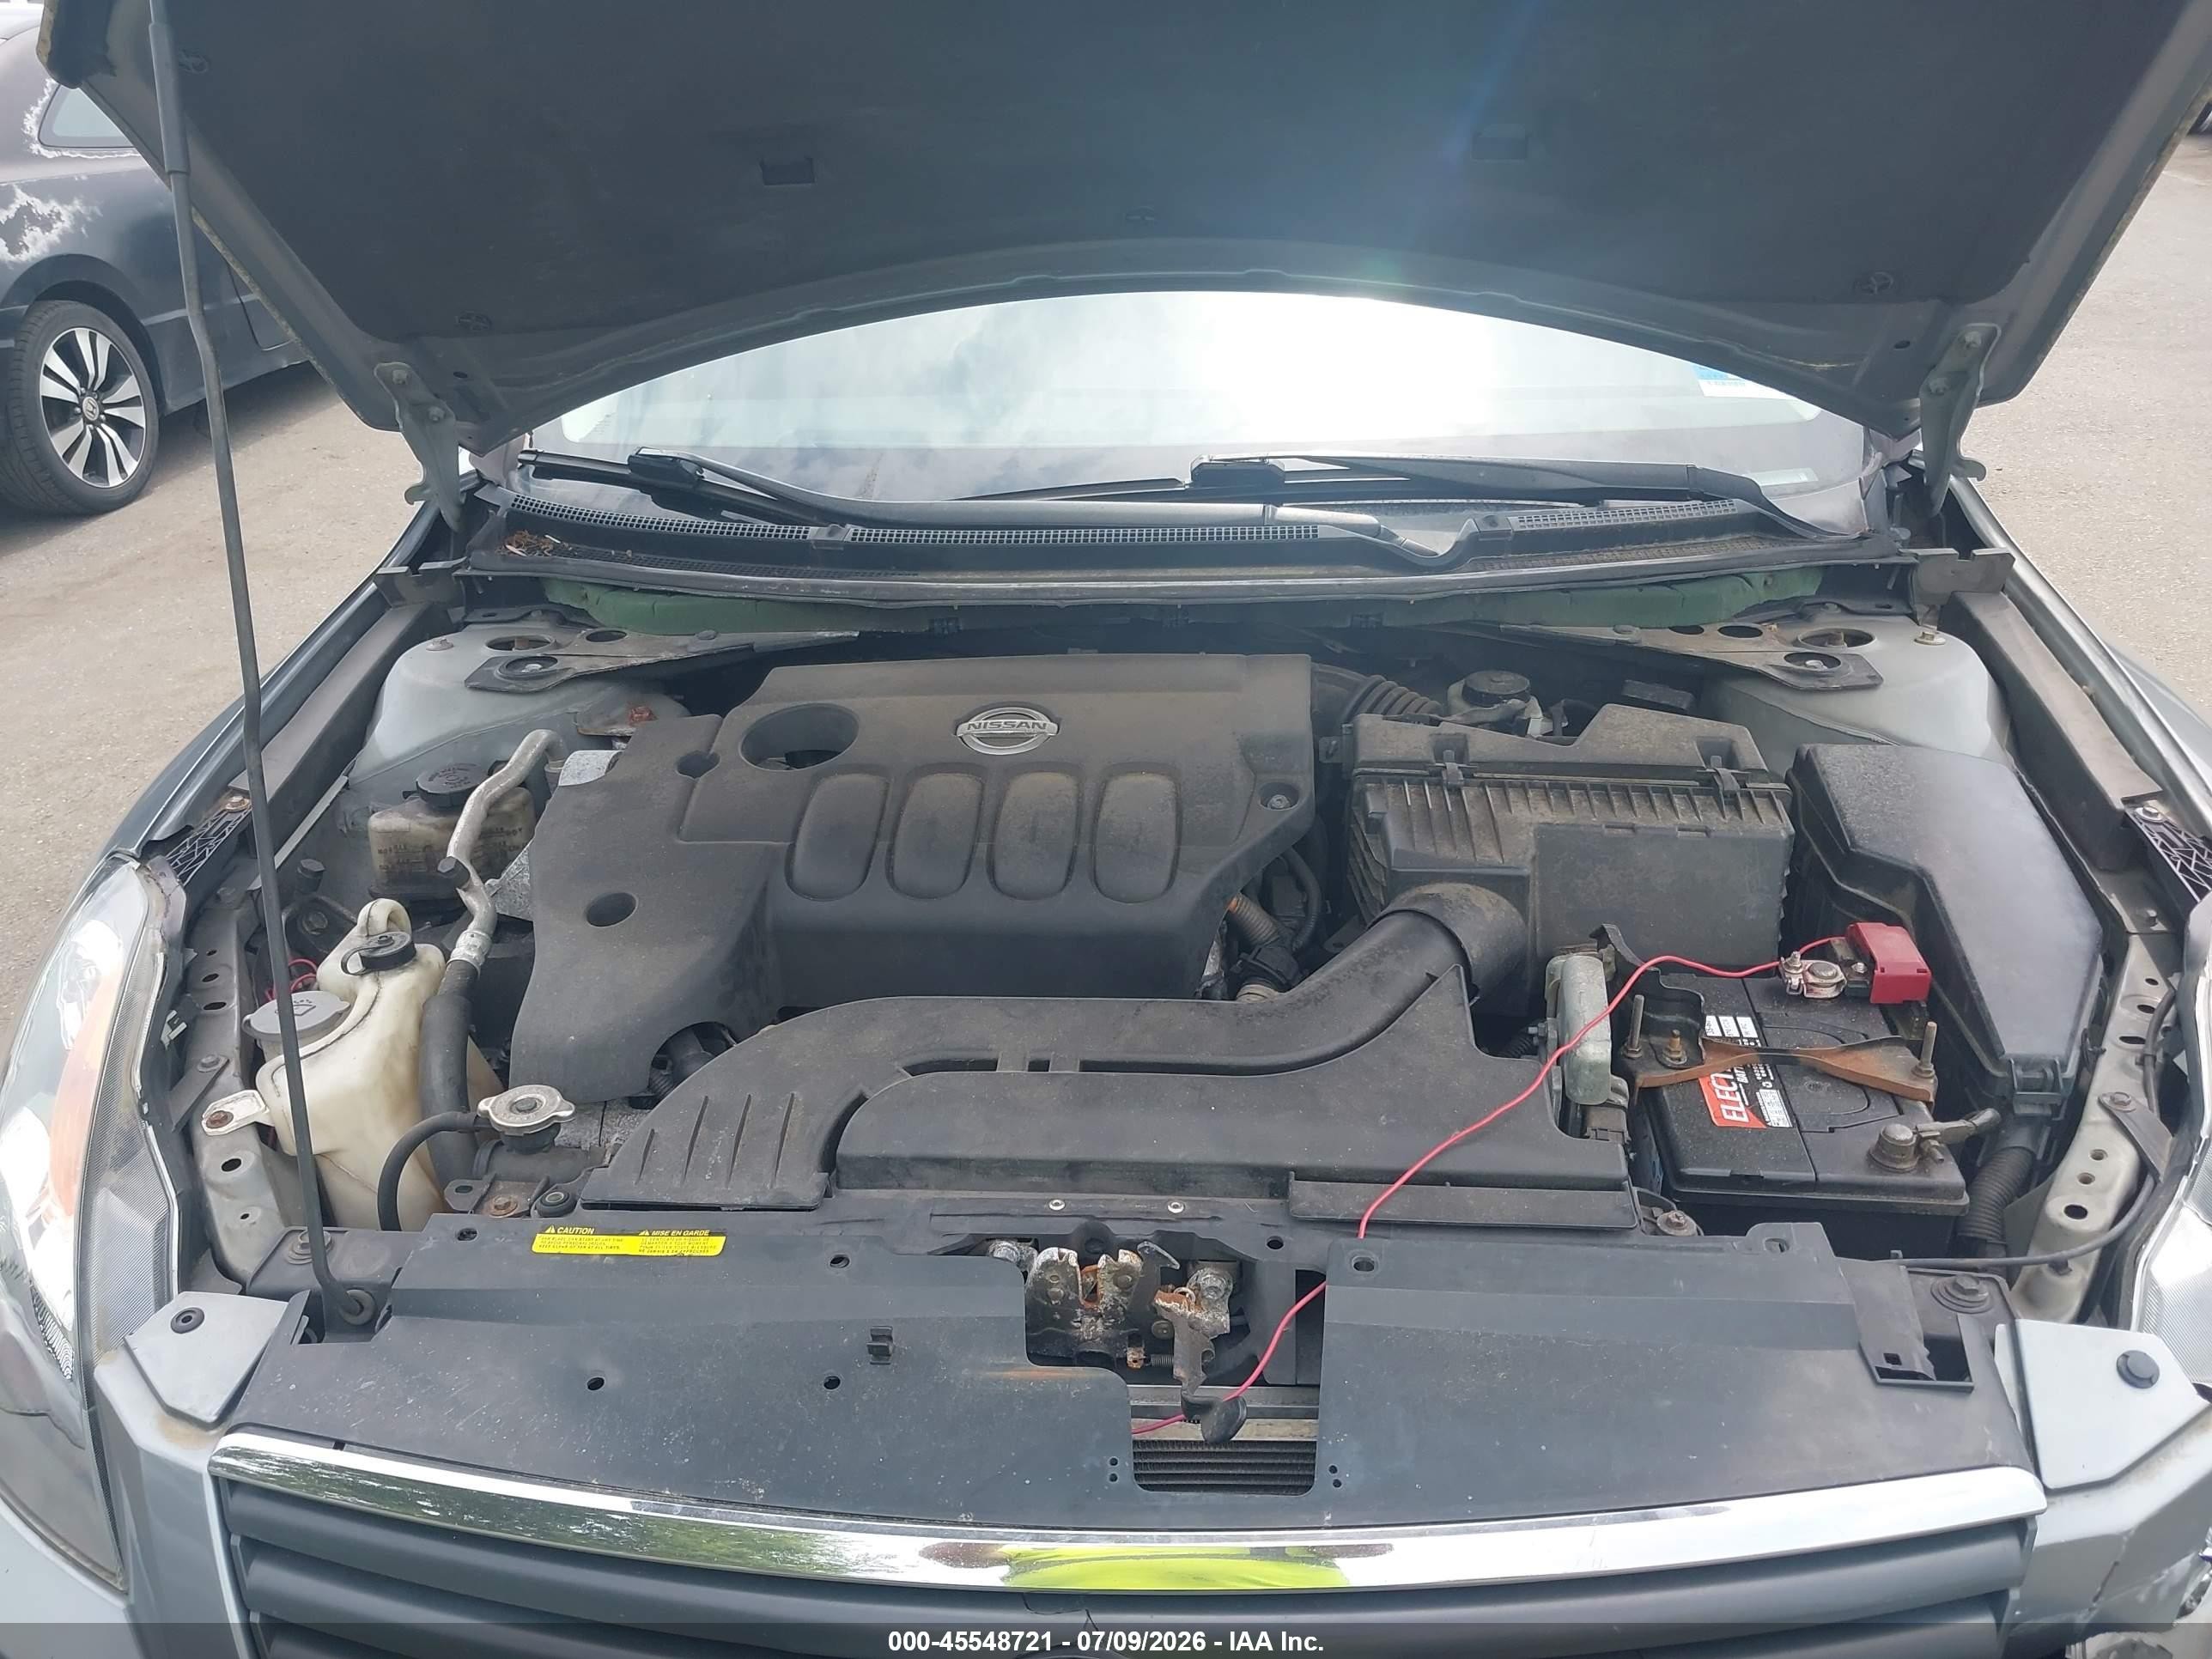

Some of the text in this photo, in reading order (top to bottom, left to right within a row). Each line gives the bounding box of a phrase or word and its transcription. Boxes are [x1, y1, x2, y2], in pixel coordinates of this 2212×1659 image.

[967, 720, 1047, 731] NISSAN
[1734, 1066, 1749, 1084] BATT
[1711, 1069, 1749, 1122] ELECT
[557, 1226, 595, 1235] CAUTION
